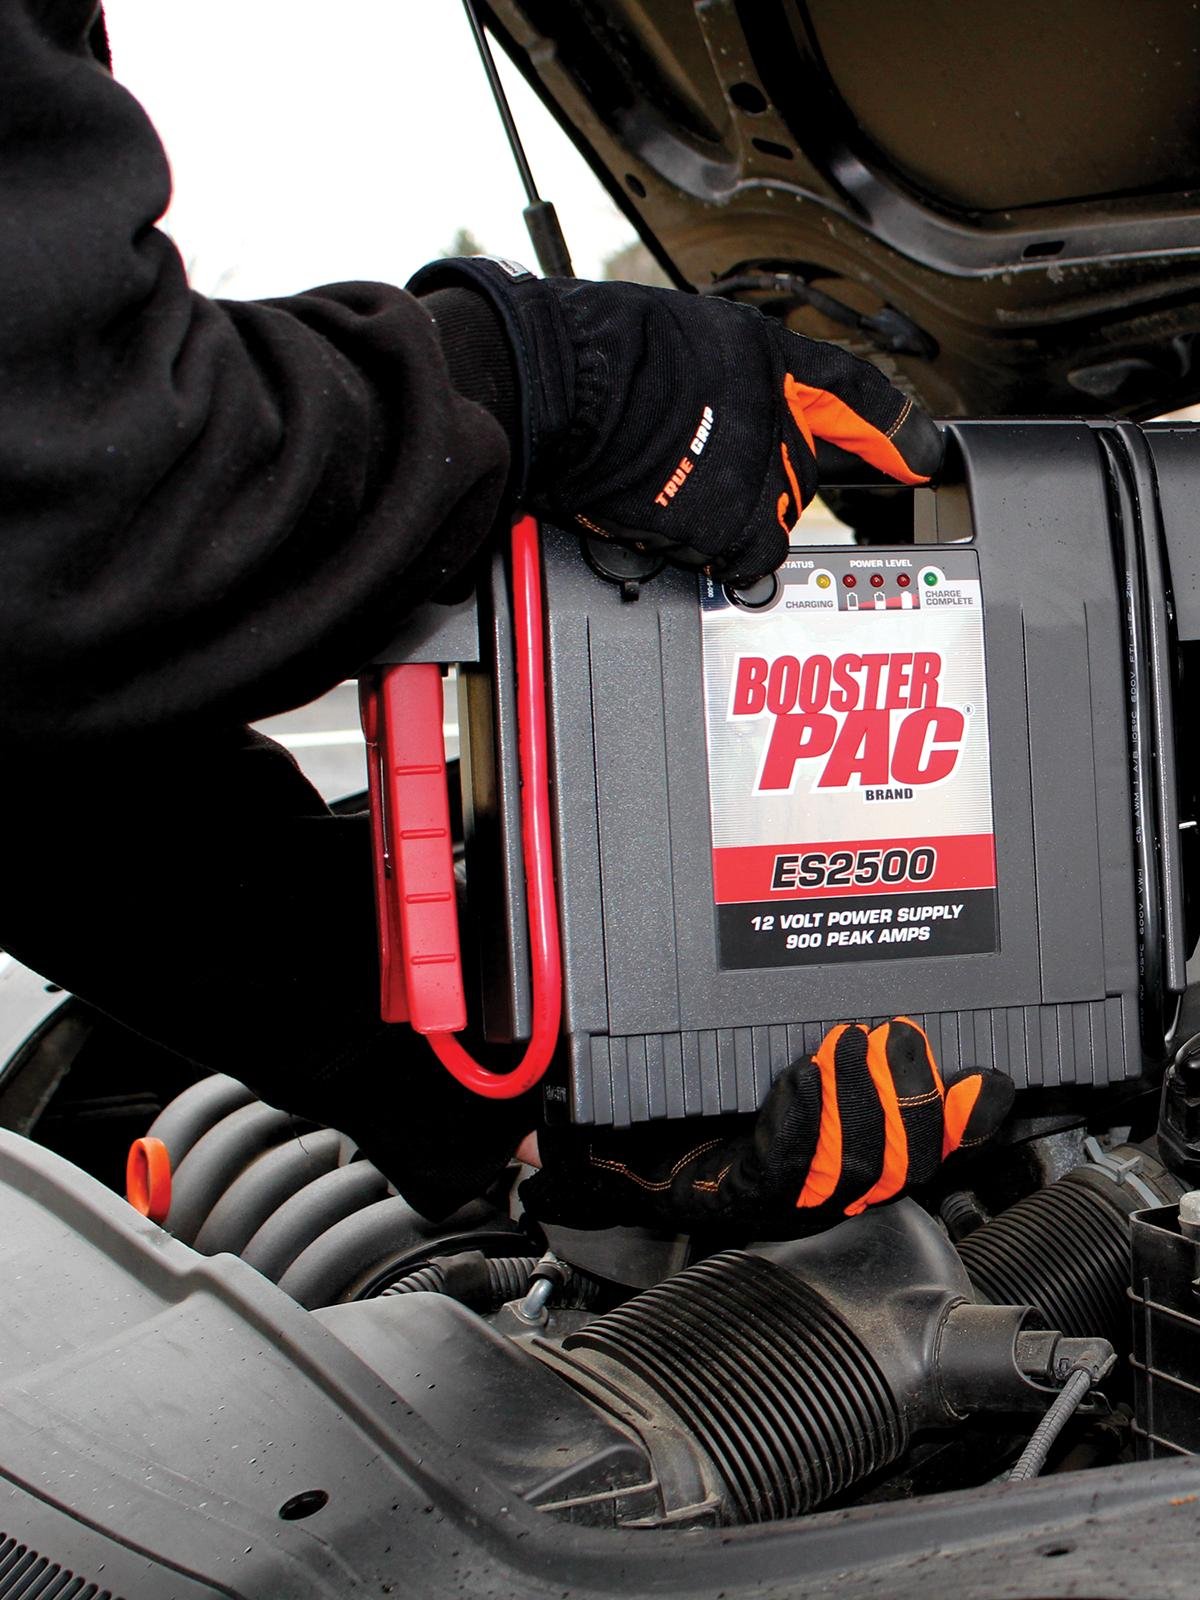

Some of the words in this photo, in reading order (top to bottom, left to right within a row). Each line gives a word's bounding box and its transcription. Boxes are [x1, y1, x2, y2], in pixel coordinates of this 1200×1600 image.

[655, 457, 694, 507] TRUE
[690, 406, 714, 456] GRIP
[780, 560, 814, 569] STATUS
[850, 560, 883, 568] POWER
[885, 559, 912, 567] LEVEL
[925, 590, 962, 598] CHARGE
[926, 597, 973, 606] COMPLETE
[786, 600, 834, 609] CHARGING
[732, 652, 942, 716] BOOSTER
[758, 707, 965, 790] PAC
[865, 788, 913, 801] BRAND
[771, 848, 936, 889] ES2500
[750, 916, 774, 931] 12
[780, 912, 823, 930] VOLT
[828, 909, 892, 928] POWER
[897, 904, 964, 923] SUPPLY
[786, 934, 822, 950] 900
[826, 930, 874, 947] PEAK
[878, 926, 931, 944] AMPS
